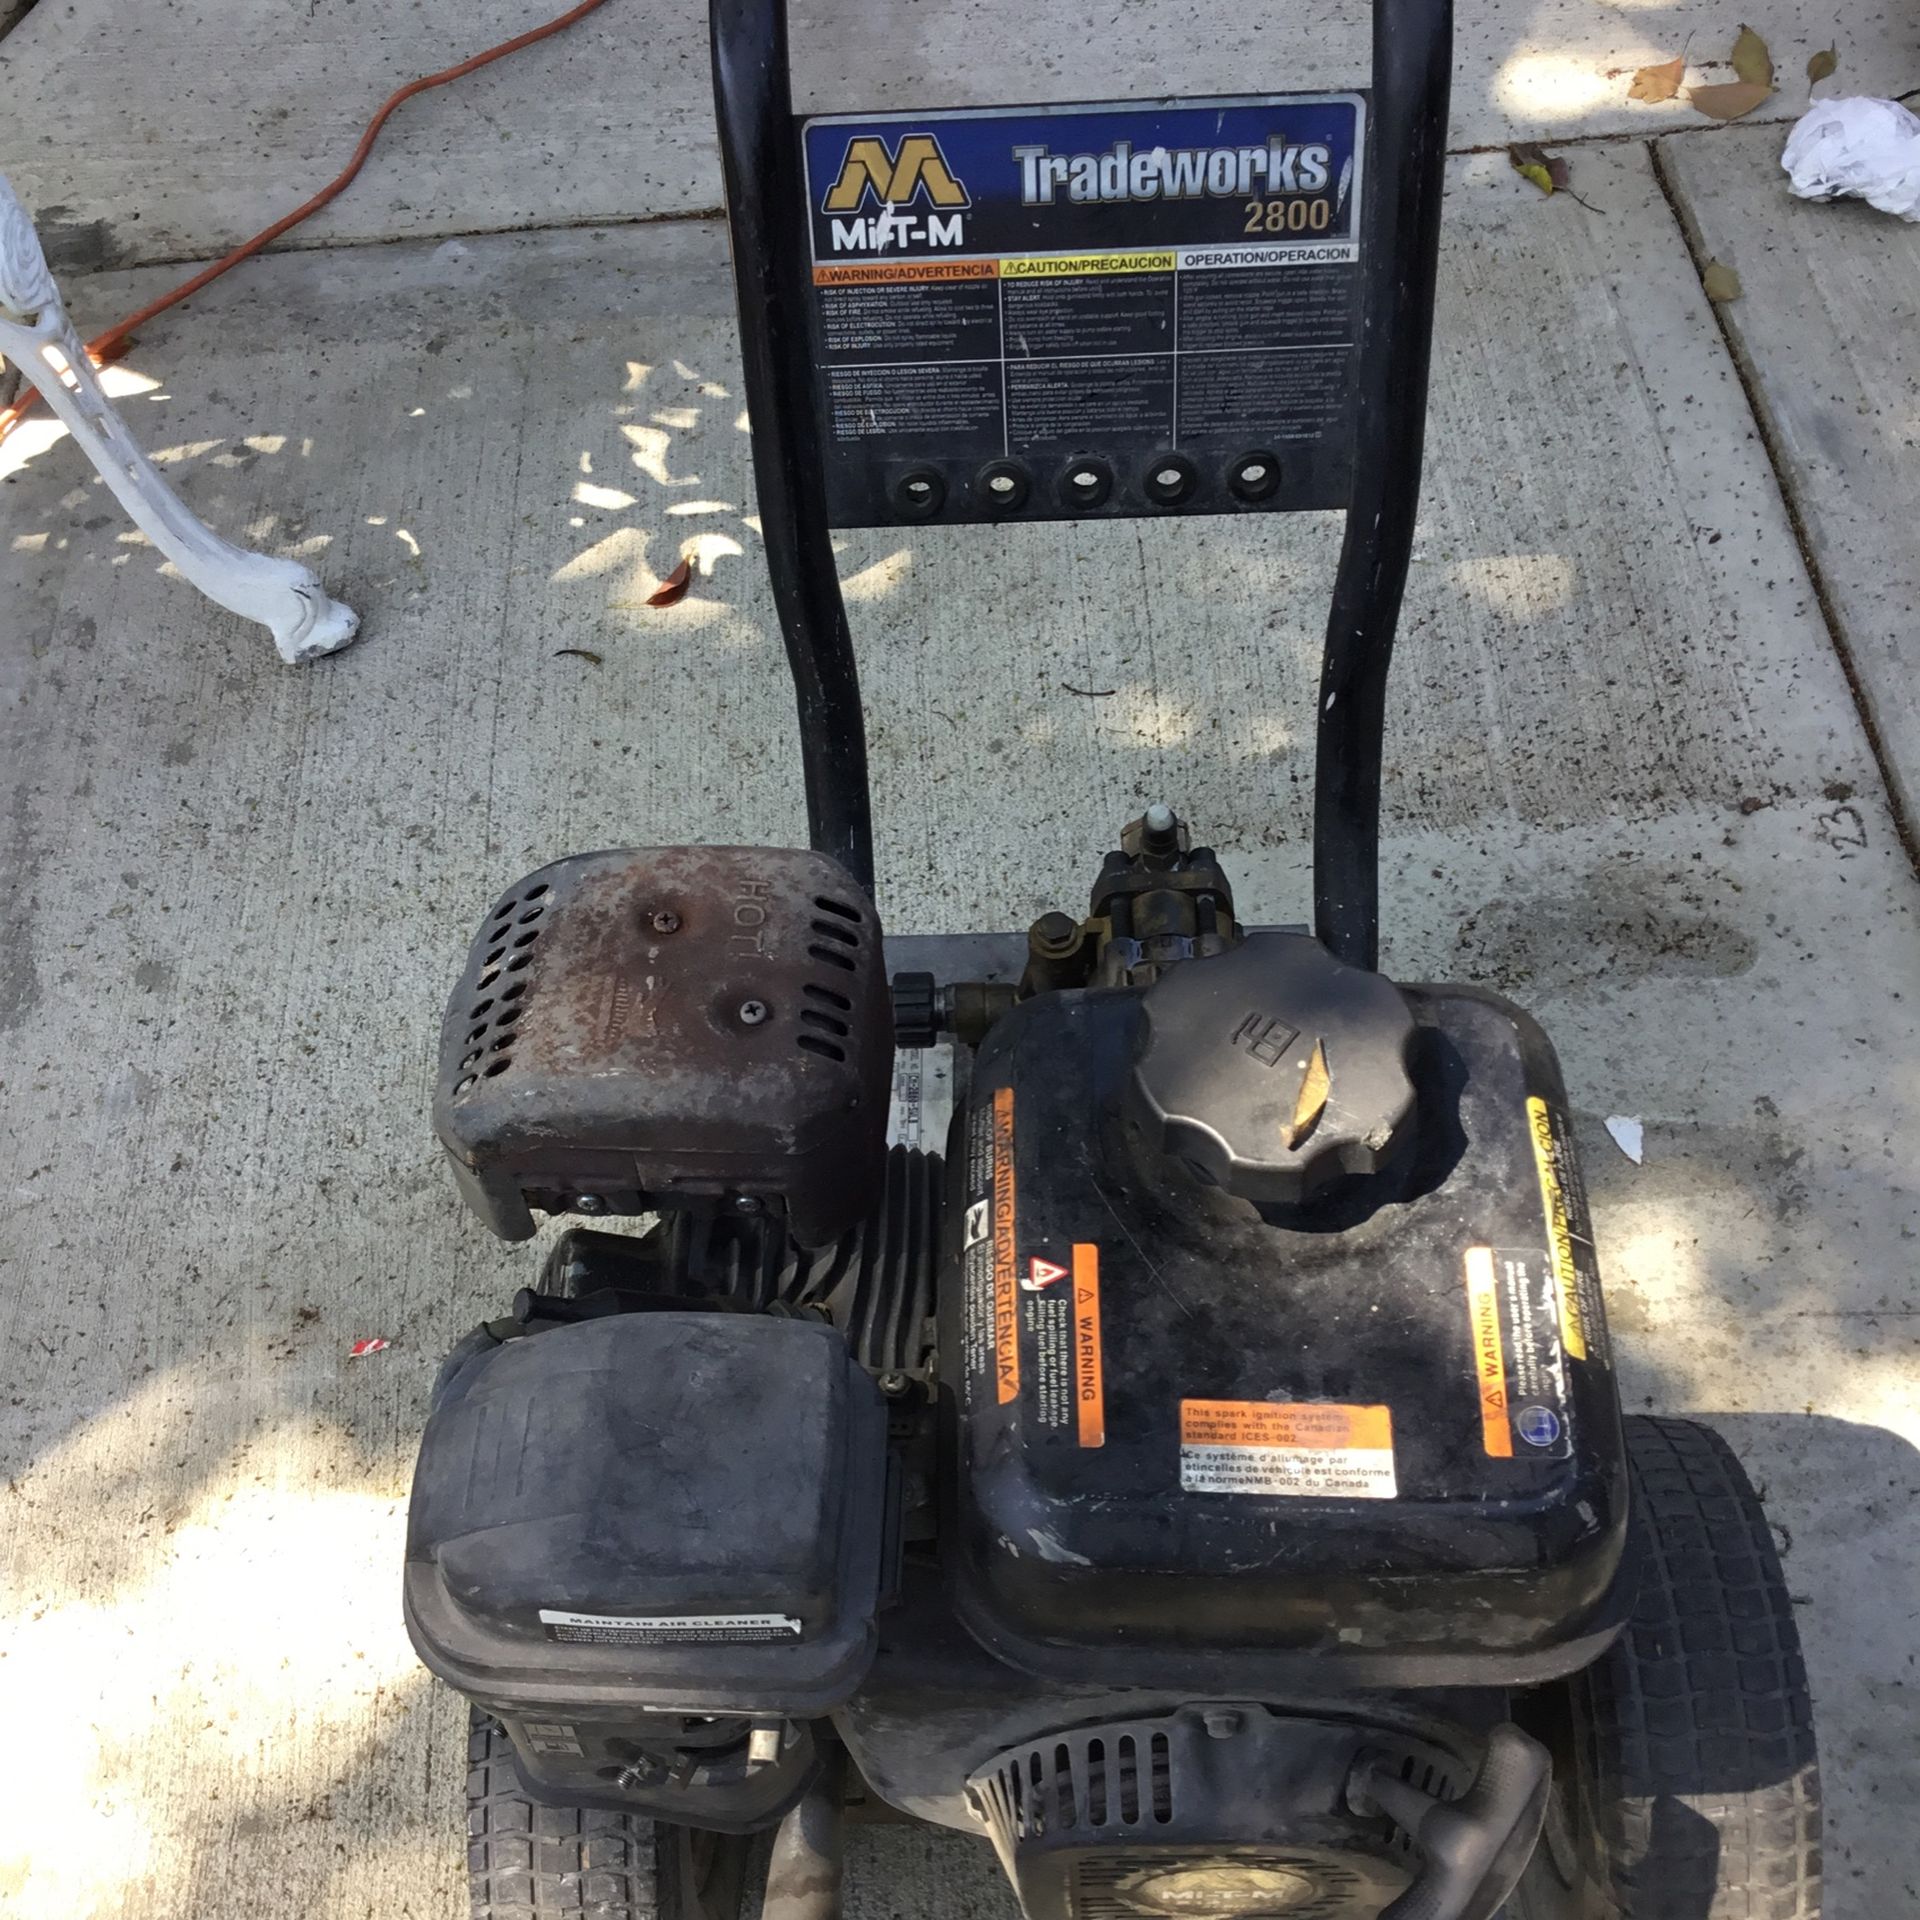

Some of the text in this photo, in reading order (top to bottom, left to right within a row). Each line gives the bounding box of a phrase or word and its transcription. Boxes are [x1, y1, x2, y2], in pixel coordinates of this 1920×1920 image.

[1012, 134, 1330, 206] Tradeworks
[1243, 199, 1330, 234] 2800
[1017, 256, 1172, 274] CAUTION/PRECAUCION
[1185, 248, 1350, 267] OPERATION/OPERACION
[830, 264, 994, 282] WARNING/ADVERTENCIA
[984, 1143, 993, 1180] BURNS
[996, 1121, 1014, 1378] WARNING/ADVERTENCIA
[985, 1282, 993, 1298] DE
[1574, 1267, 1586, 1295] FIRE
[1025, 1300, 1036, 1332] engine
[1047, 1299, 1057, 1319] fuel
[1508, 1294, 1520, 1324] user's
[1579, 1297, 1588, 1313] OF
[985, 1300, 995, 1350] QUEMAR
[1478, 1293, 1499, 1378] WARNING
[1511, 1325, 1521, 1340] the
[1515, 1261, 1540, 1396] carefully before operating the
[1581, 1314, 1593, 1343] RISK
[1038, 1331, 1047, 1350] fuel
[1047, 1319, 1058, 1356] spilling
[1049, 1356, 1057, 1368] or
[1058, 1299, 1070, 1425] Check that there is not any
[1080, 1317, 1096, 1401] WARNING
[1512, 1340, 1524, 1363] read
[1038, 1351, 1048, 1383] before
[1049, 1368, 1059, 1388] fuel
[1515, 1364, 1527, 1396] Please
[1037, 1384, 1048, 1423] starting
[1186, 1408, 1210, 1418] This
[1215, 1409, 1247, 1420] spark
[1252, 1410, 1296, 1421] ignition
[1185, 1420, 1349, 1433] complies with the Canadian
[1186, 1431, 1237, 1441] standard
[1244, 1464, 1259, 1473] de
[1314, 1466, 1332, 1476] est
[1335, 1466, 1391, 1477] conforme
[1259, 1453, 1324, 1465] d'allumage
[1329, 1456, 1348, 1465] par
[1305, 1477, 1320, 1487] du
[1325, 1477, 1370, 1488] Canada
[570, 1617, 772, 1627] MAINTAIN AIR CLEANER
